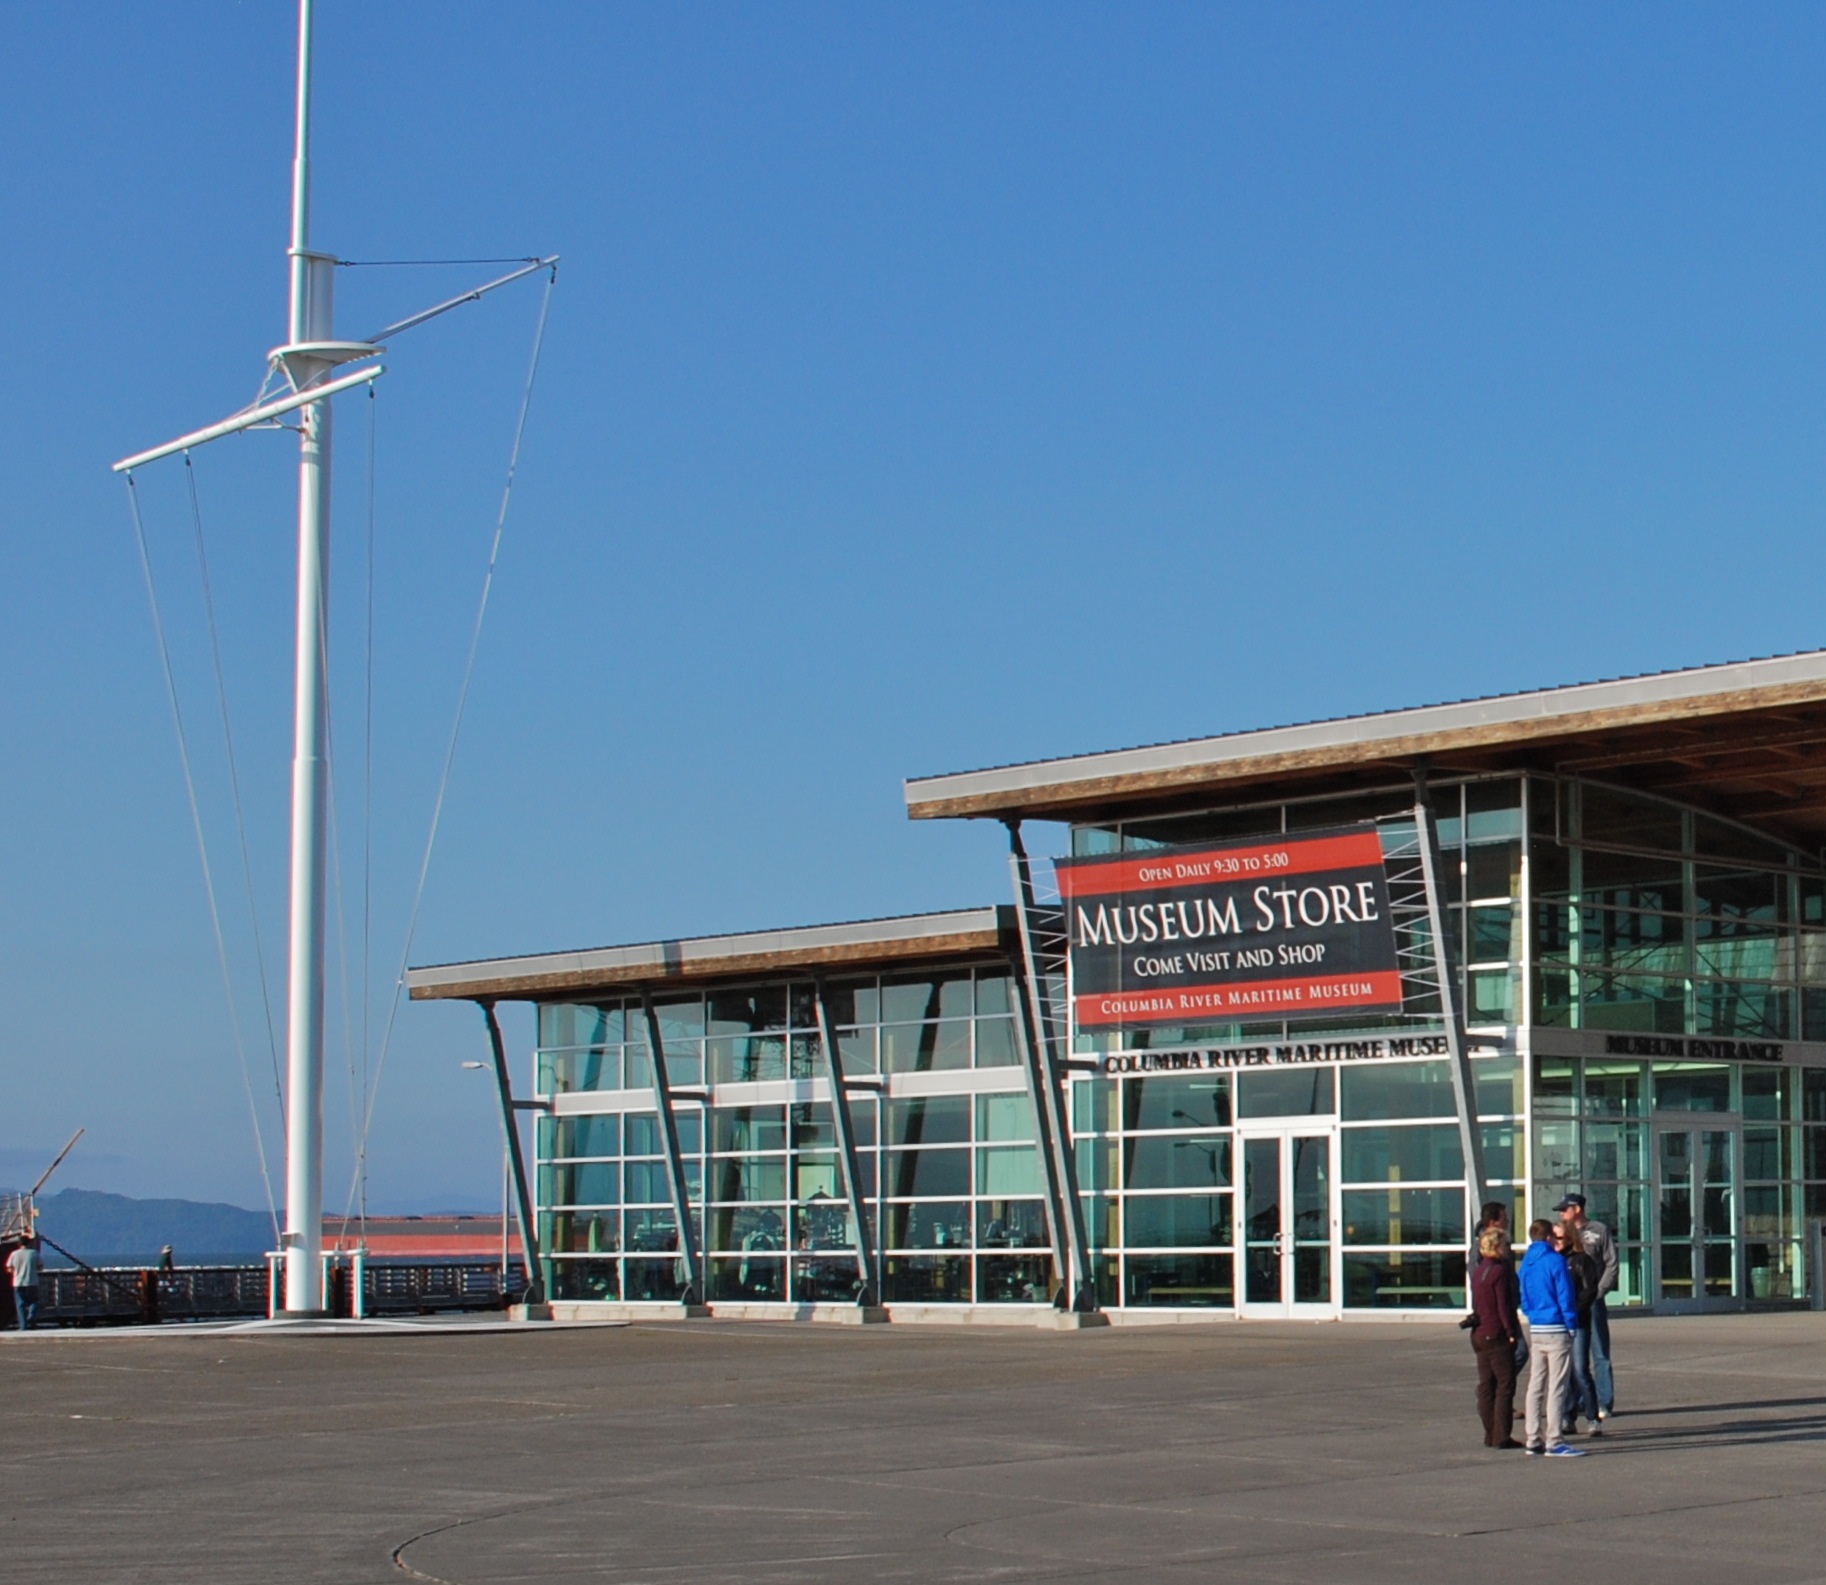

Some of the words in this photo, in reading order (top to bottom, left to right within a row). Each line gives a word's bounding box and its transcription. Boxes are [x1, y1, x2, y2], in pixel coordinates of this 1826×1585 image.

[1139, 867, 1173, 882] OPEN
[1175, 863, 1211, 878] DAILY
[1214, 858, 1240, 873] 9:30
[1242, 857, 1260, 871] TO
[1263, 852, 1289, 869] 5:00
[1077, 896, 1243, 948] MUSEUM
[1254, 881, 1379, 932] STORE
[1133, 956, 1184, 977] COME
[1186, 952, 1230, 972] VISIT
[1236, 949, 1274, 969] AND
[1278, 943, 1326, 965] SHOP
[1101, 998, 1174, 1014] COLUMBIA
[1180, 993, 1222, 1009] RIVER
[1229, 987, 1302, 1005] MARITIME
[1309, 982, 1373, 999] MUSEUM
[1104, 1051, 1202, 1074] COLUMBIA
[1208, 1047, 1273, 1069] RIVER
[1276, 1040, 1384, 1063] MARITIME
[1688, 1040, 1784, 1062] ENTRANCE
